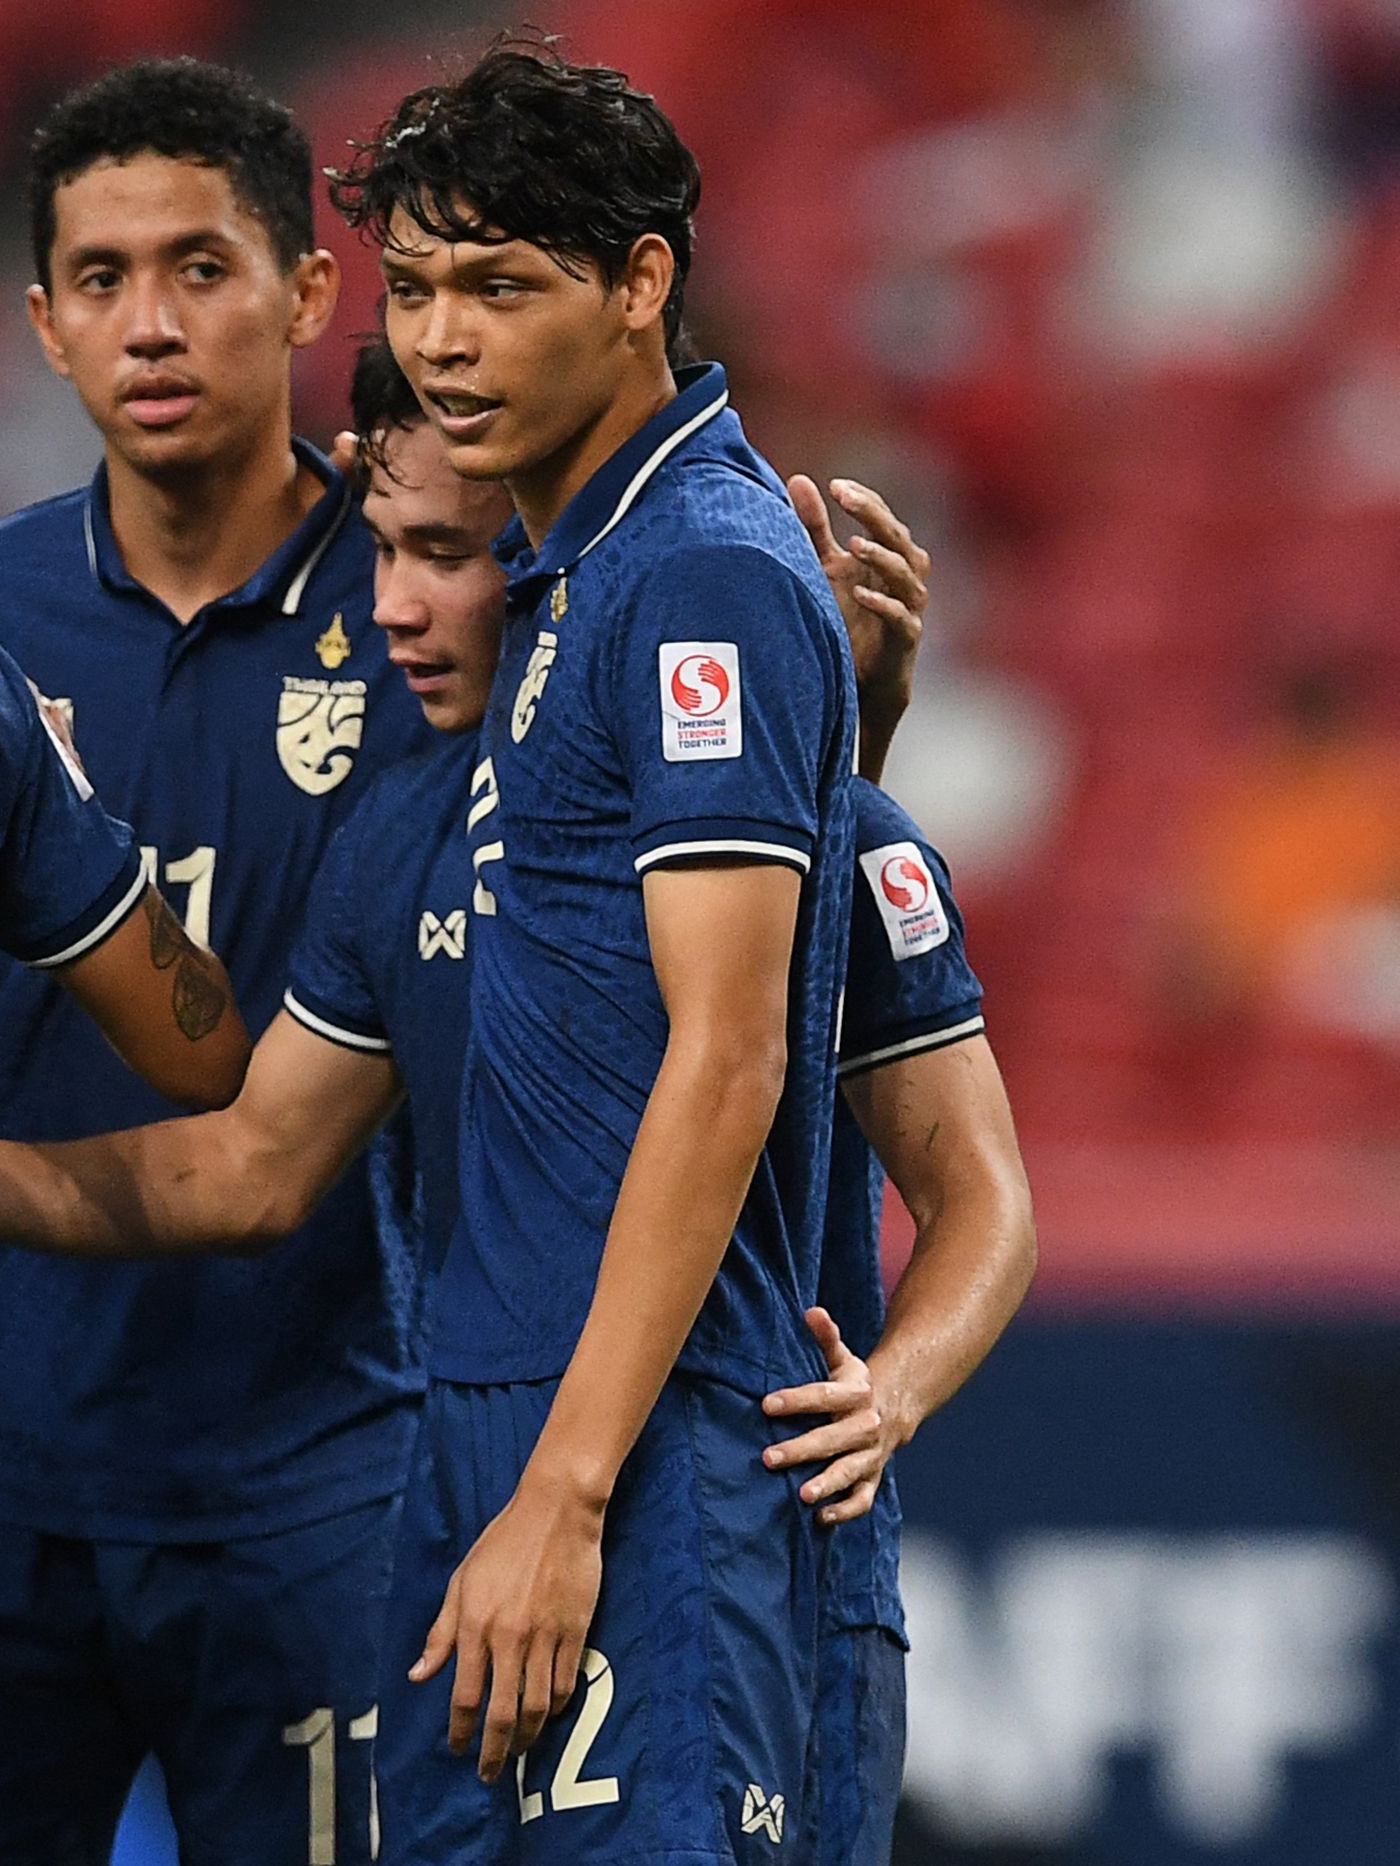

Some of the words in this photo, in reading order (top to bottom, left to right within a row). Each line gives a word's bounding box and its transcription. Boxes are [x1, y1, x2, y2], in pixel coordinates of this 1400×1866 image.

[677, 719, 726, 729] EMERGING
[677, 728, 727, 739] STRONGER
[678, 738, 727, 748] TOGETHER
